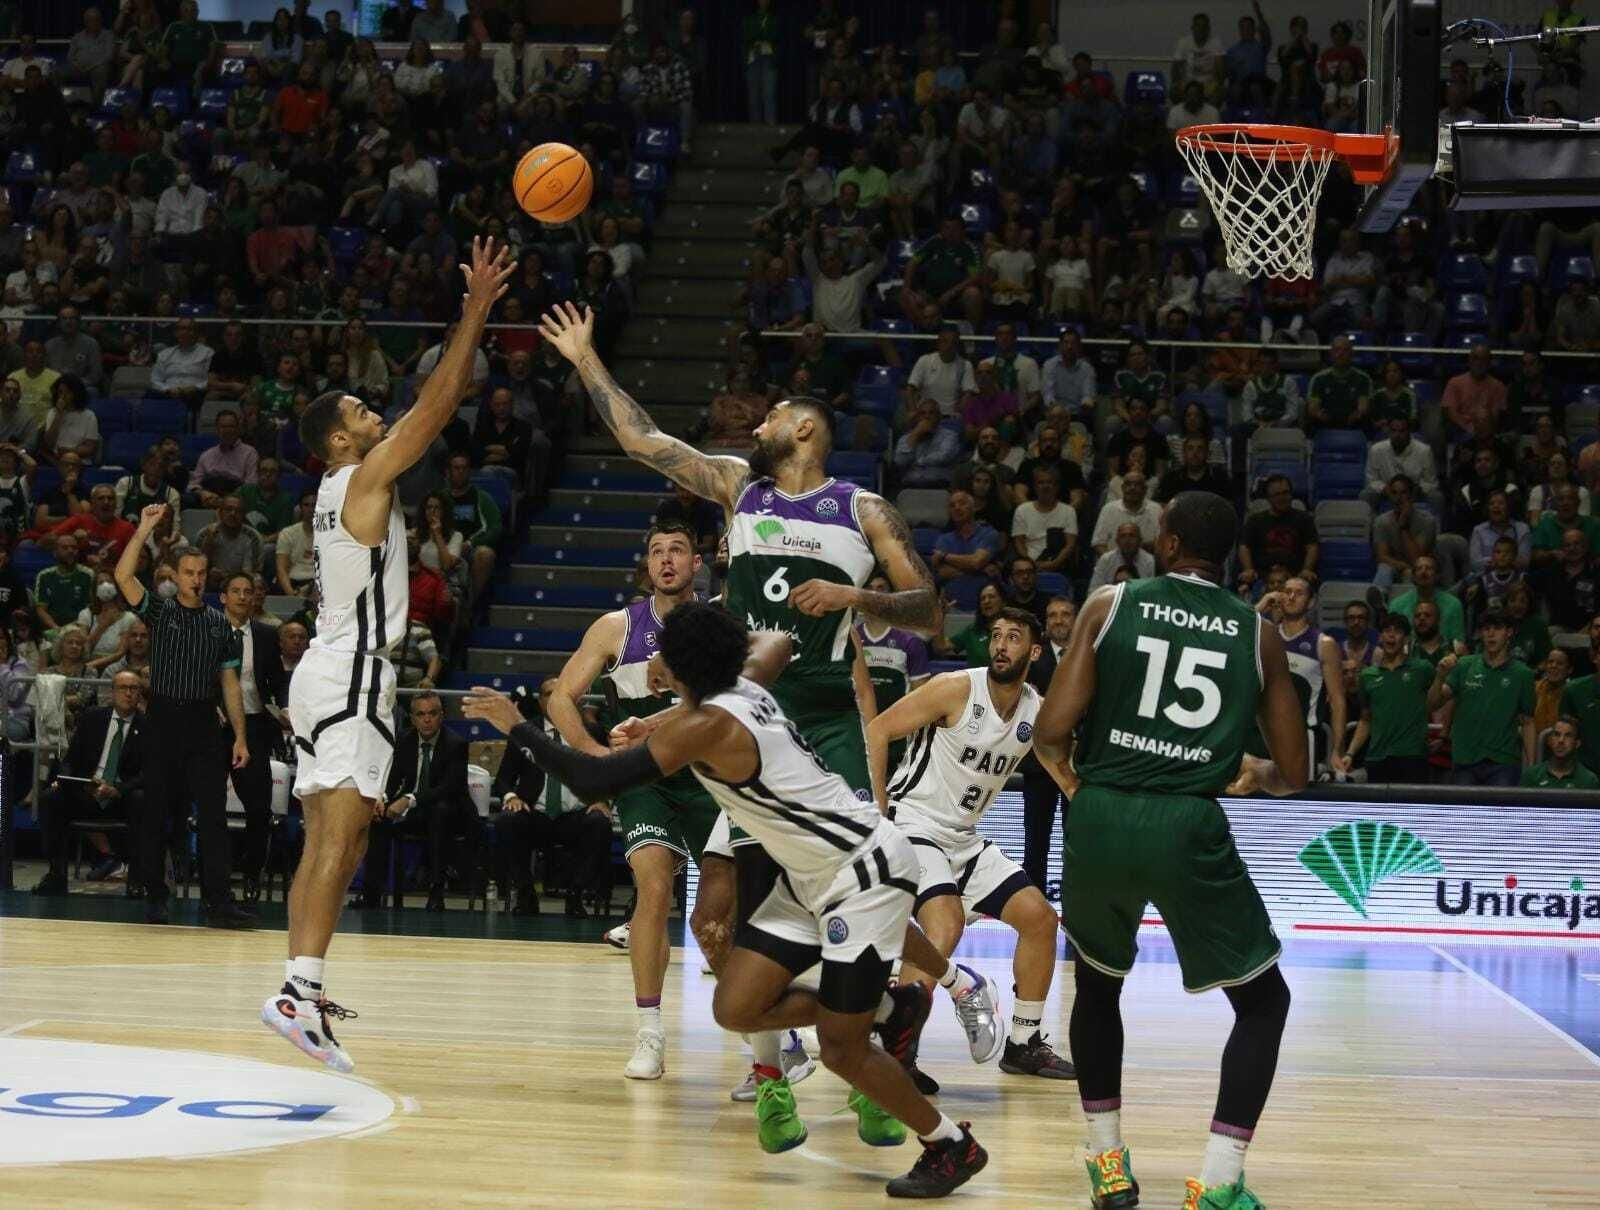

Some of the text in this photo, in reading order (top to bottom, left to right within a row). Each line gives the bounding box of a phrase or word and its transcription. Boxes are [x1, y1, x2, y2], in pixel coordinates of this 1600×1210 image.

[782, 536, 821, 551] Unicaja
[763, 566, 790, 602] 6
[1139, 602, 1239, 637] THOMAS
[1136, 635, 1228, 729] 15
[627, 823, 668, 842] málaga
[1436, 875, 1600, 930] Unicaja
